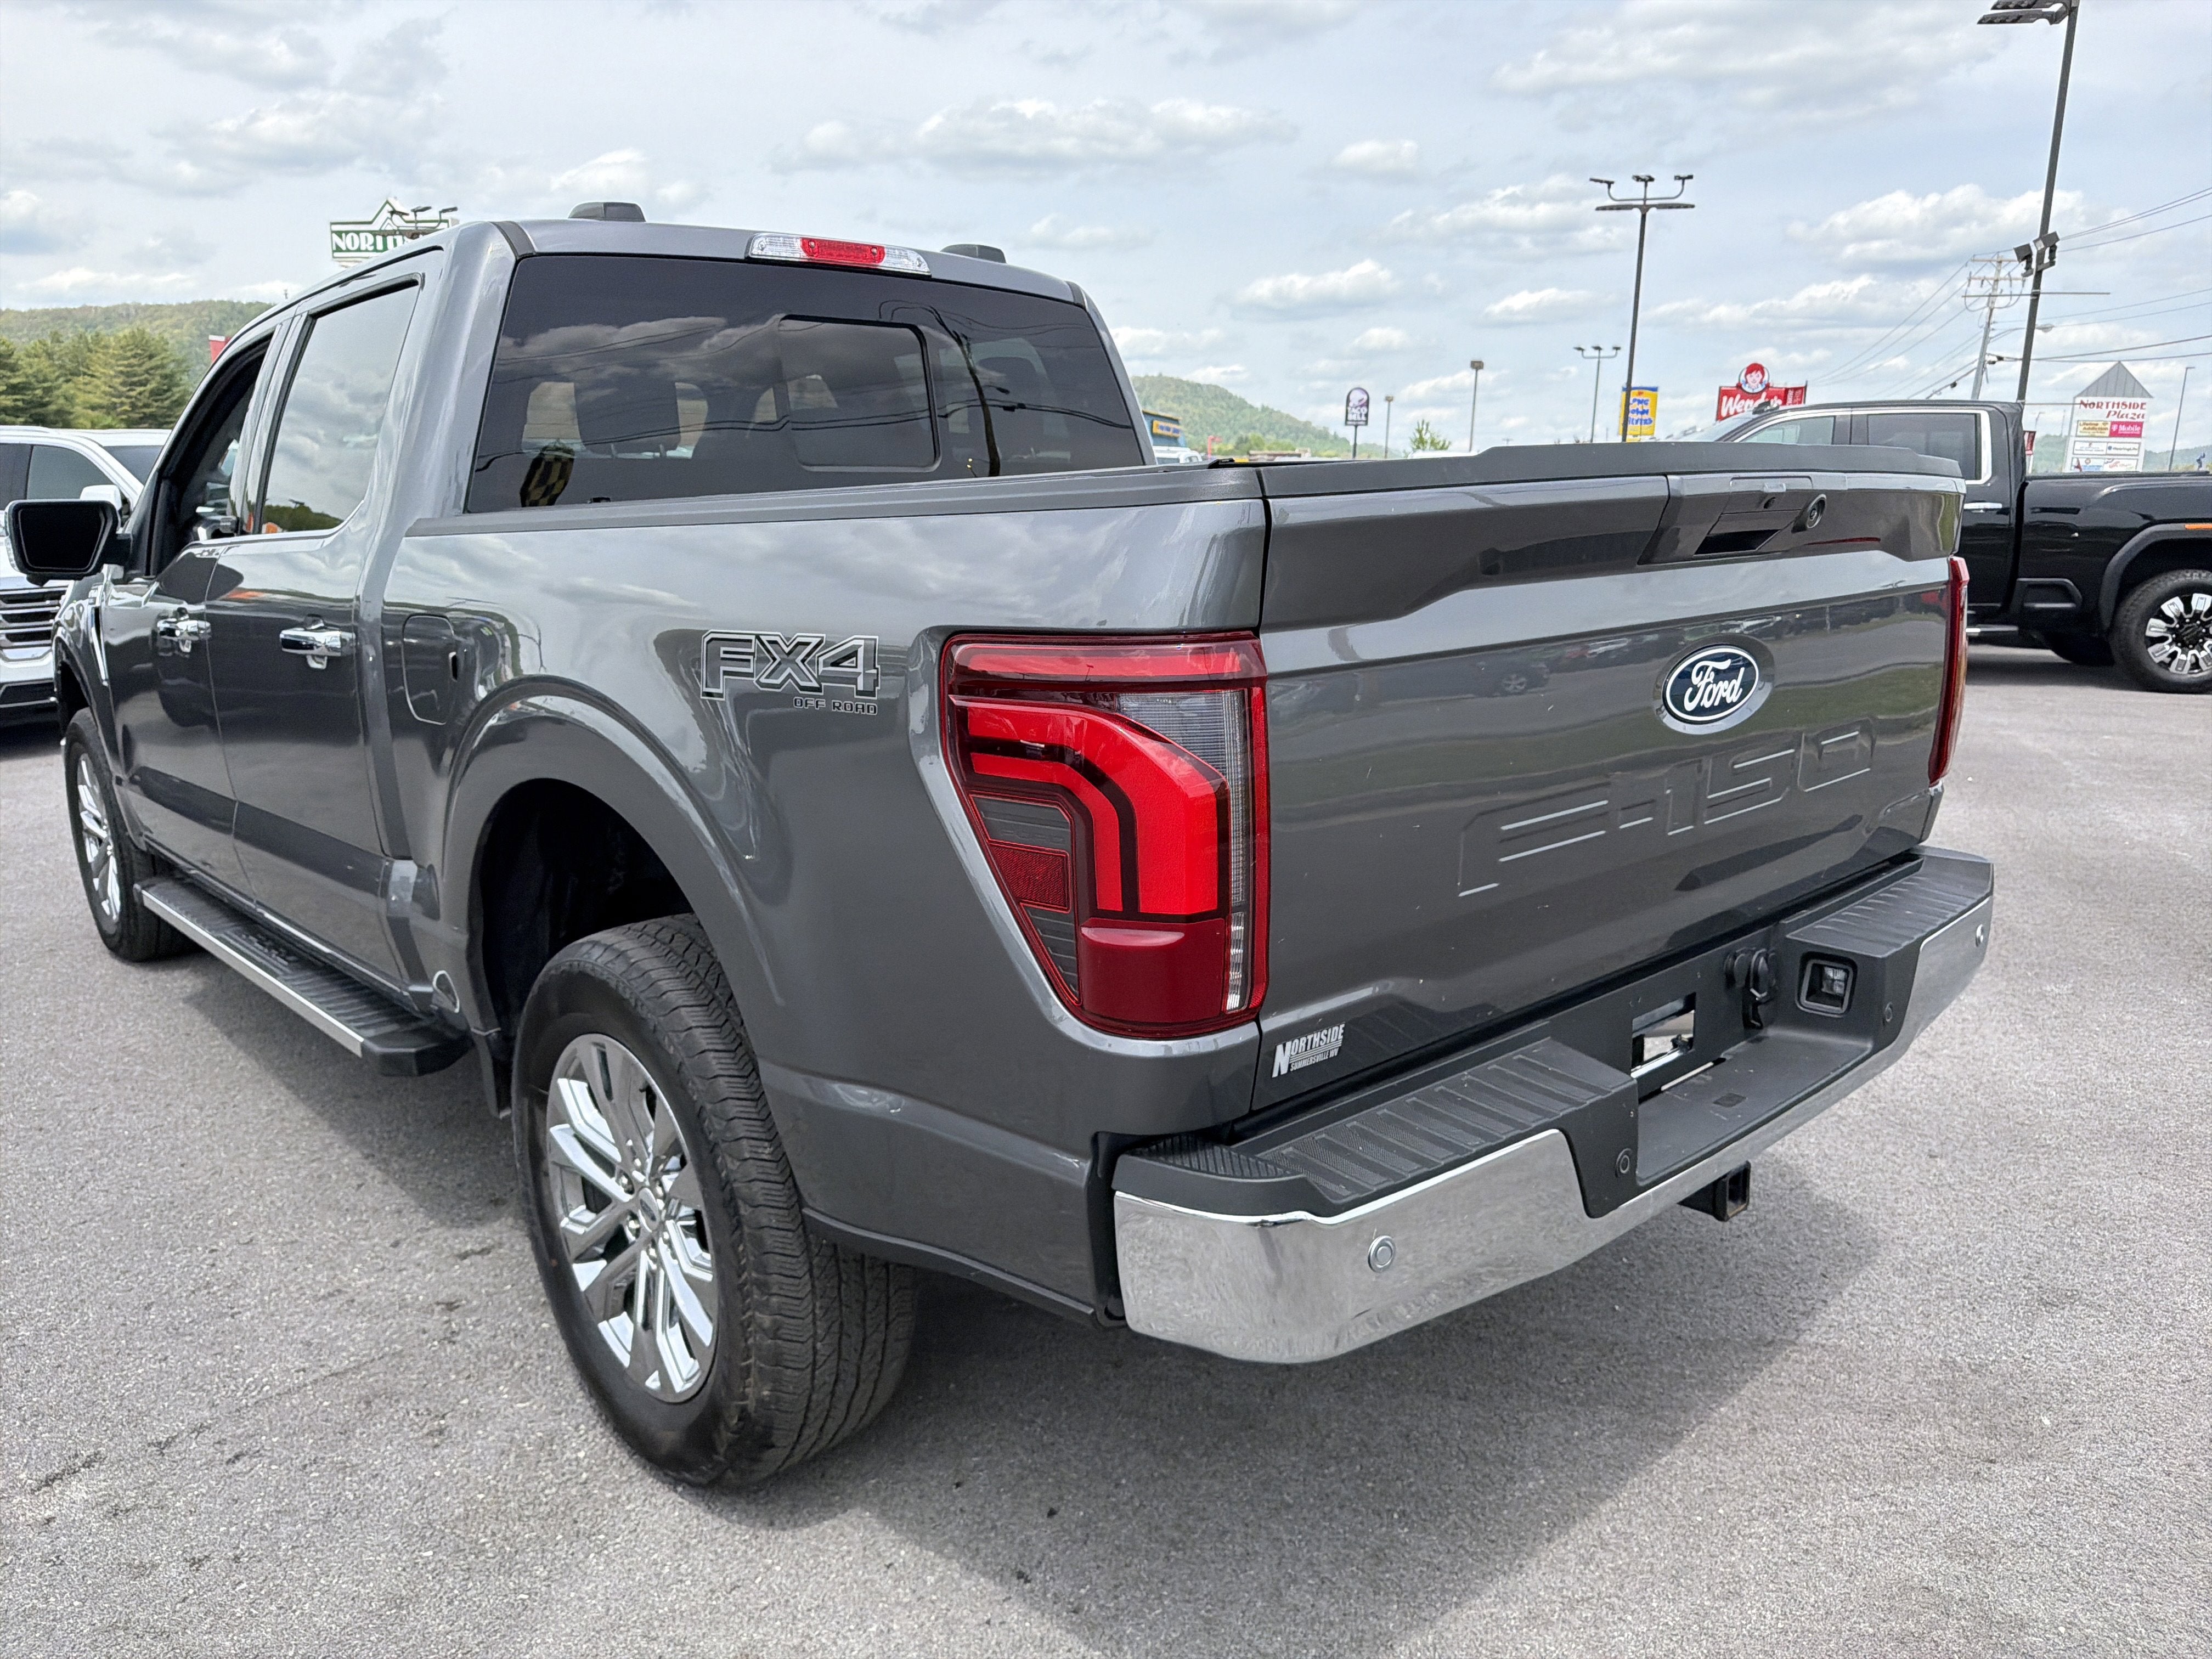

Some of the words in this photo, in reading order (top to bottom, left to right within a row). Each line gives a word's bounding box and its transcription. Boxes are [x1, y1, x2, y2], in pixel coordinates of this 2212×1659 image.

[2079, 400, 2146, 410] NORTHSIDE
[2106, 410, 2146, 420] Plaza
[701, 629, 881, 700] FX4
[1684, 659, 1745, 711] Ford
[793, 696, 826, 710] OFF
[831, 699, 878, 715] ROAD
[1272, 1023, 1346, 1078] NORTHSIDE
[1290, 1053, 1329, 1071] SUMMERSVILLE
[1329, 1047, 1339, 1058] WV
